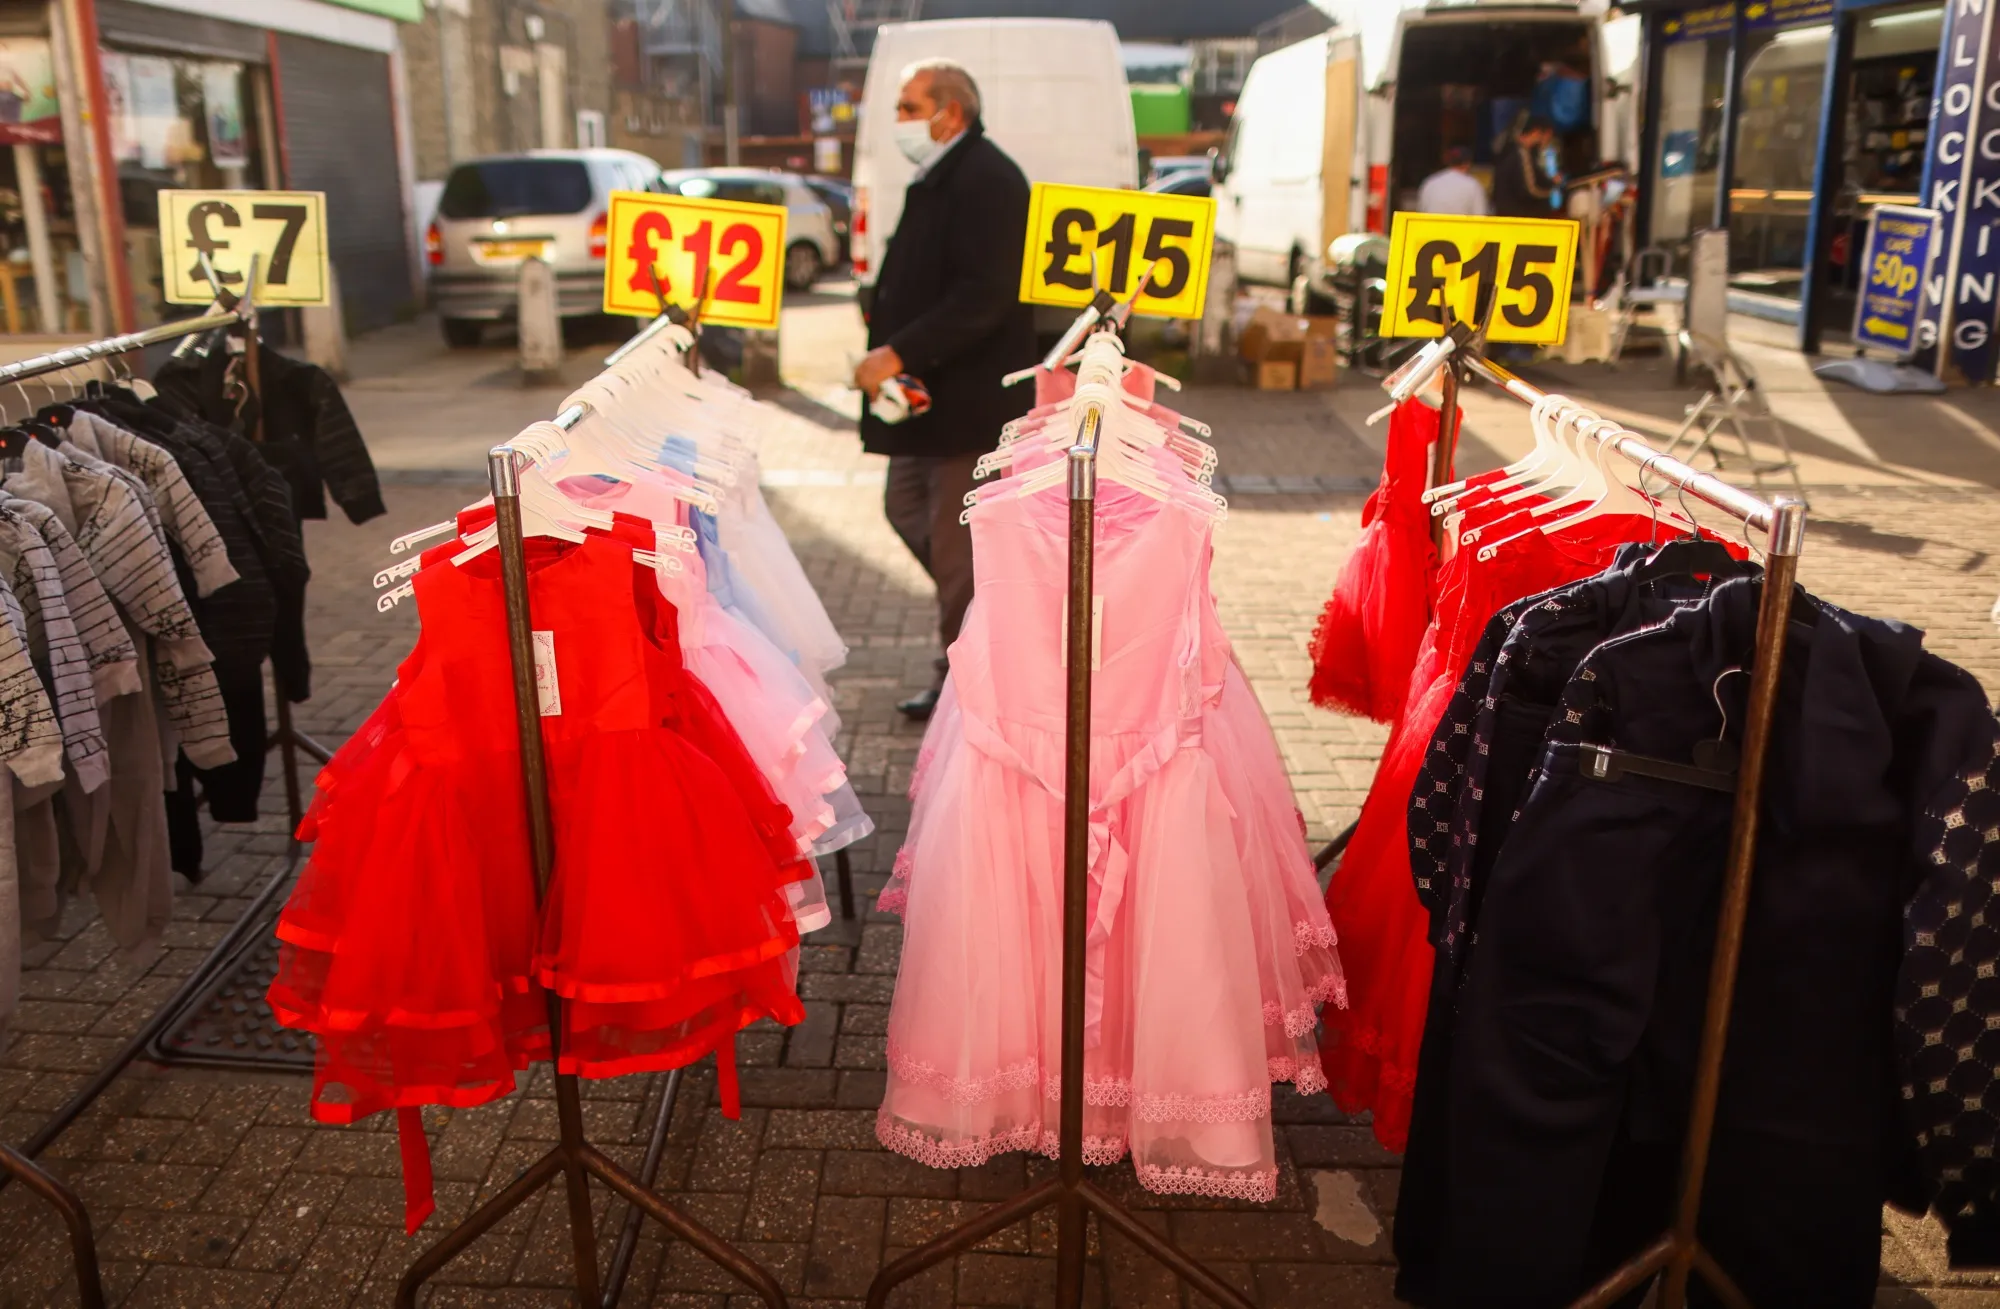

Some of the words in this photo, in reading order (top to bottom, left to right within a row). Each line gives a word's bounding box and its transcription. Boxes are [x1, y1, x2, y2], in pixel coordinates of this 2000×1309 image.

[186, 200, 307, 286] £7
[627, 210, 764, 304] £12
[1043, 207, 1194, 299] £15
[1406, 239, 1558, 328] £15
[1872, 252, 1918, 297] 50p
